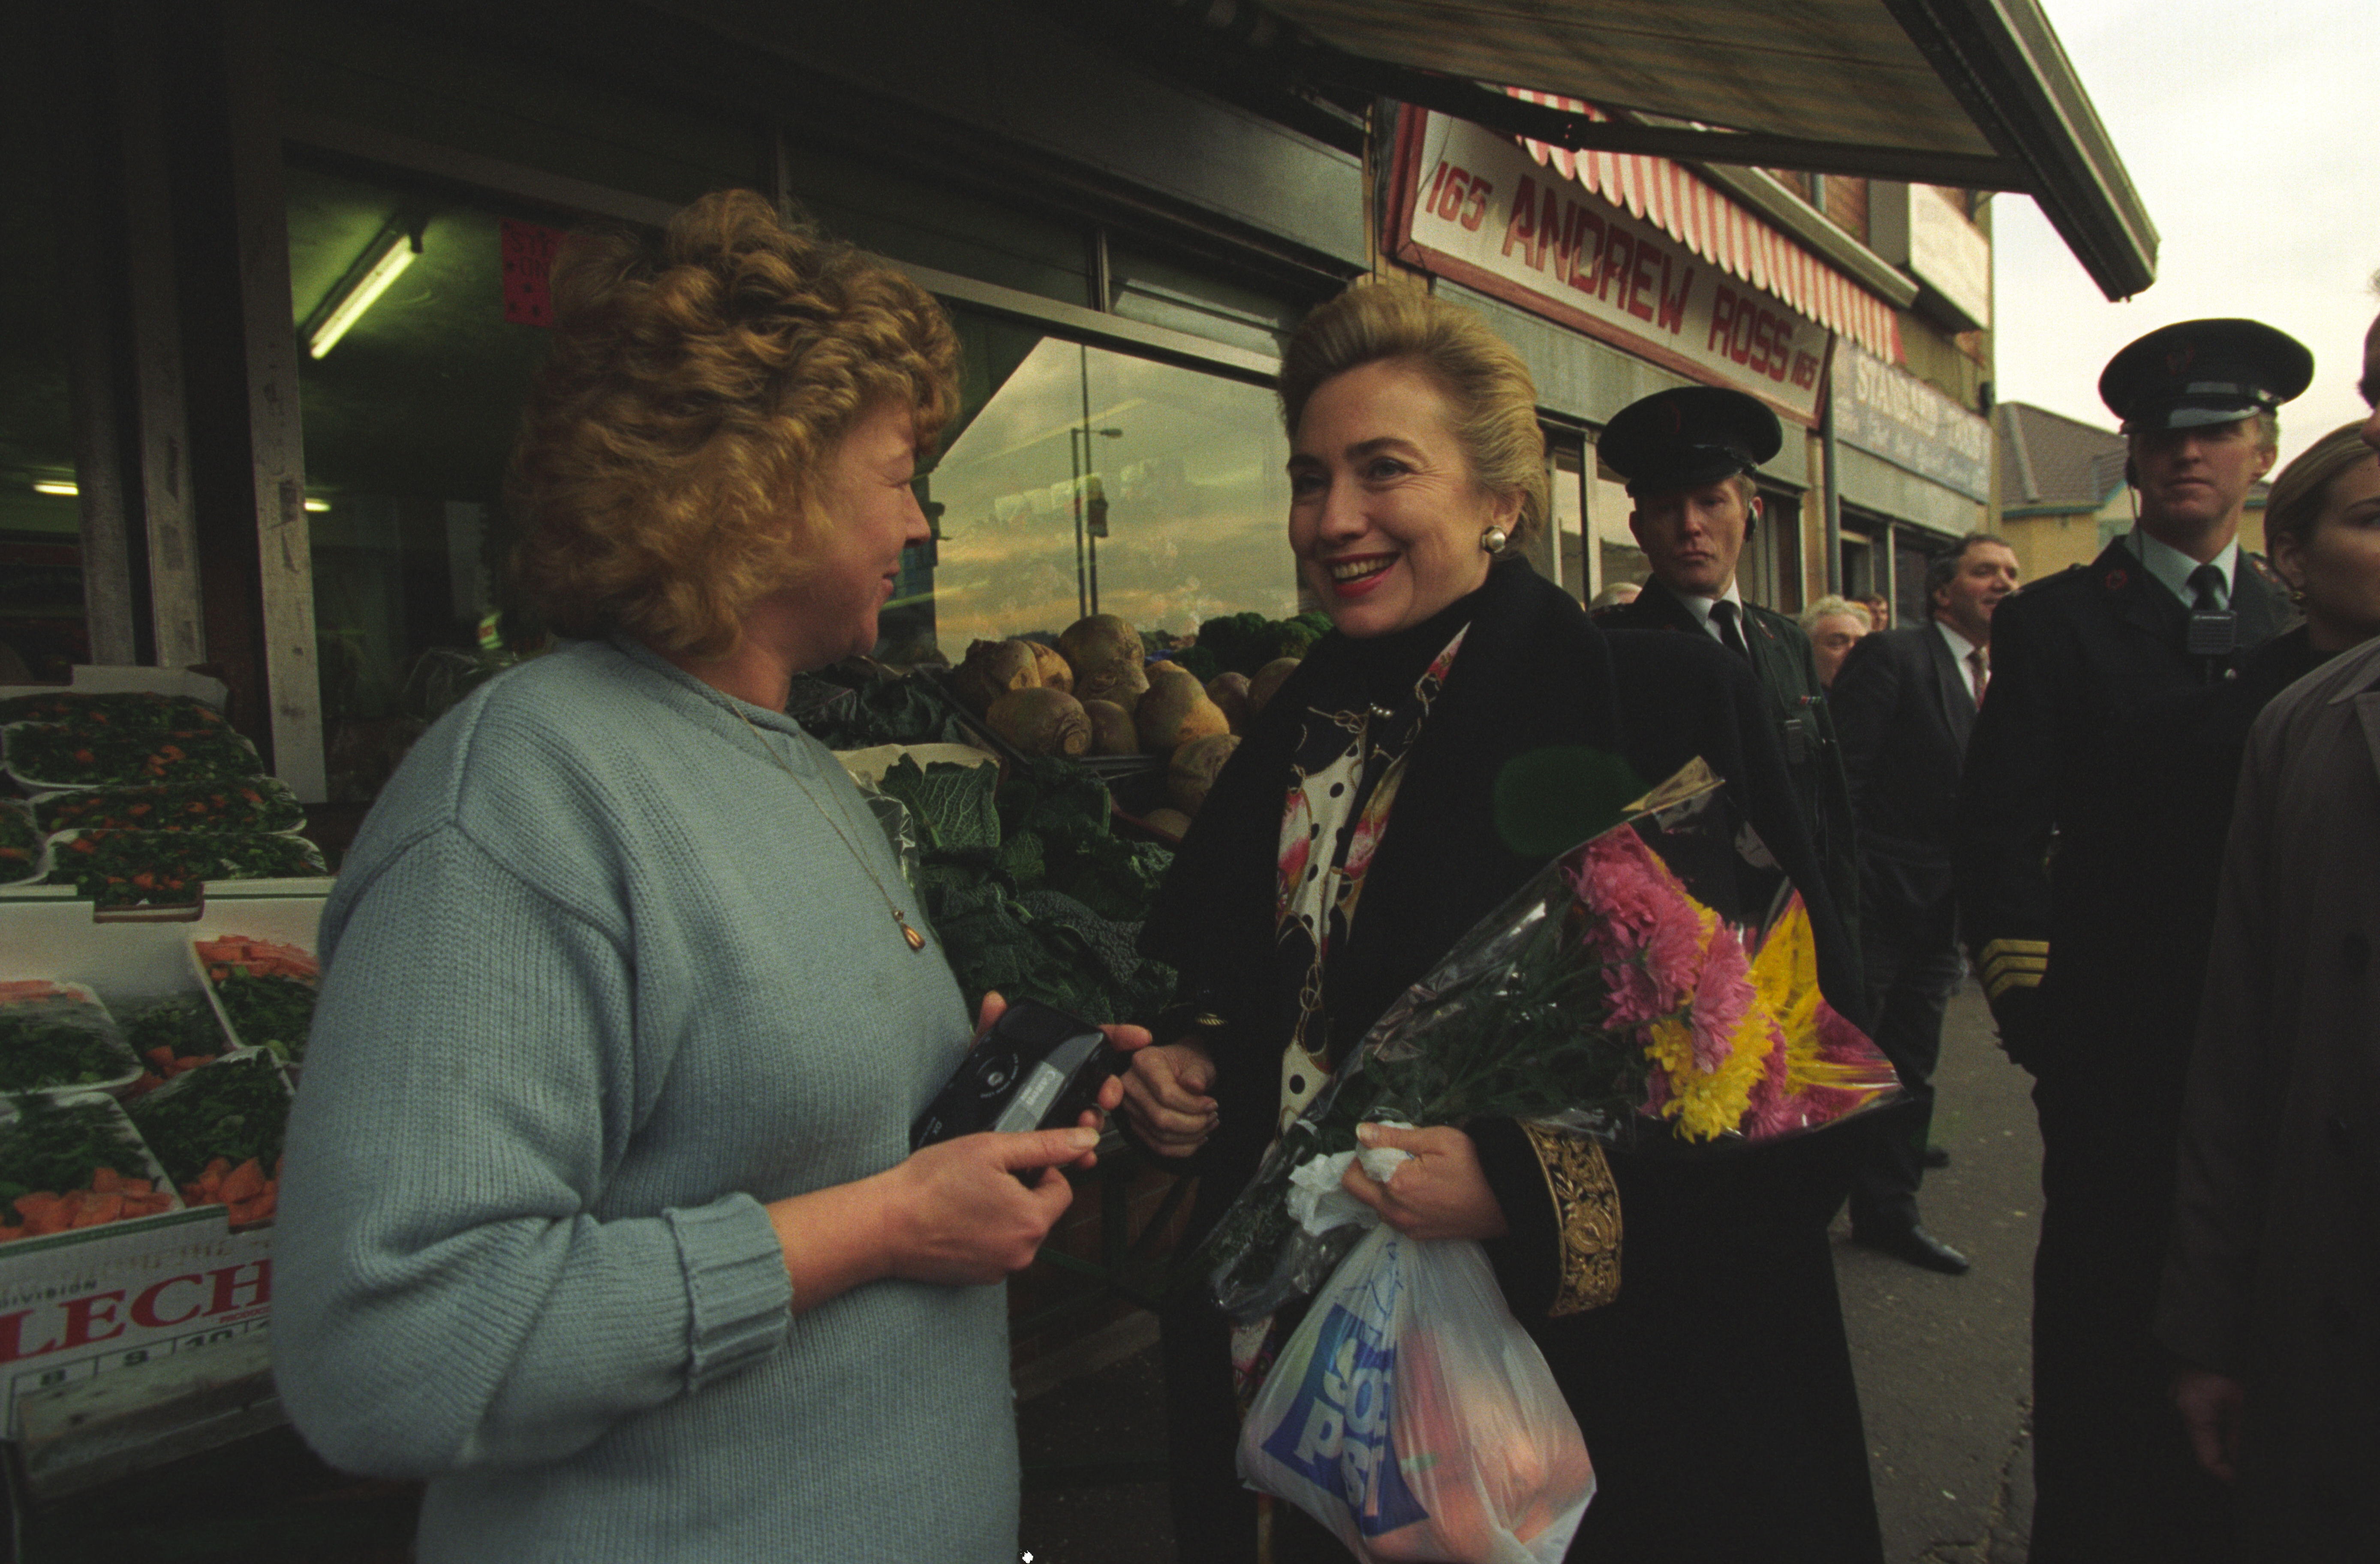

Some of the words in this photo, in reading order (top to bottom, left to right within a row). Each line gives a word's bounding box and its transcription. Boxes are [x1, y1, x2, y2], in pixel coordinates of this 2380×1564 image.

[1426, 161, 1493, 232] 165
[1501, 173, 1695, 334] ANDREW
[1708, 283, 1793, 383] ROSS
